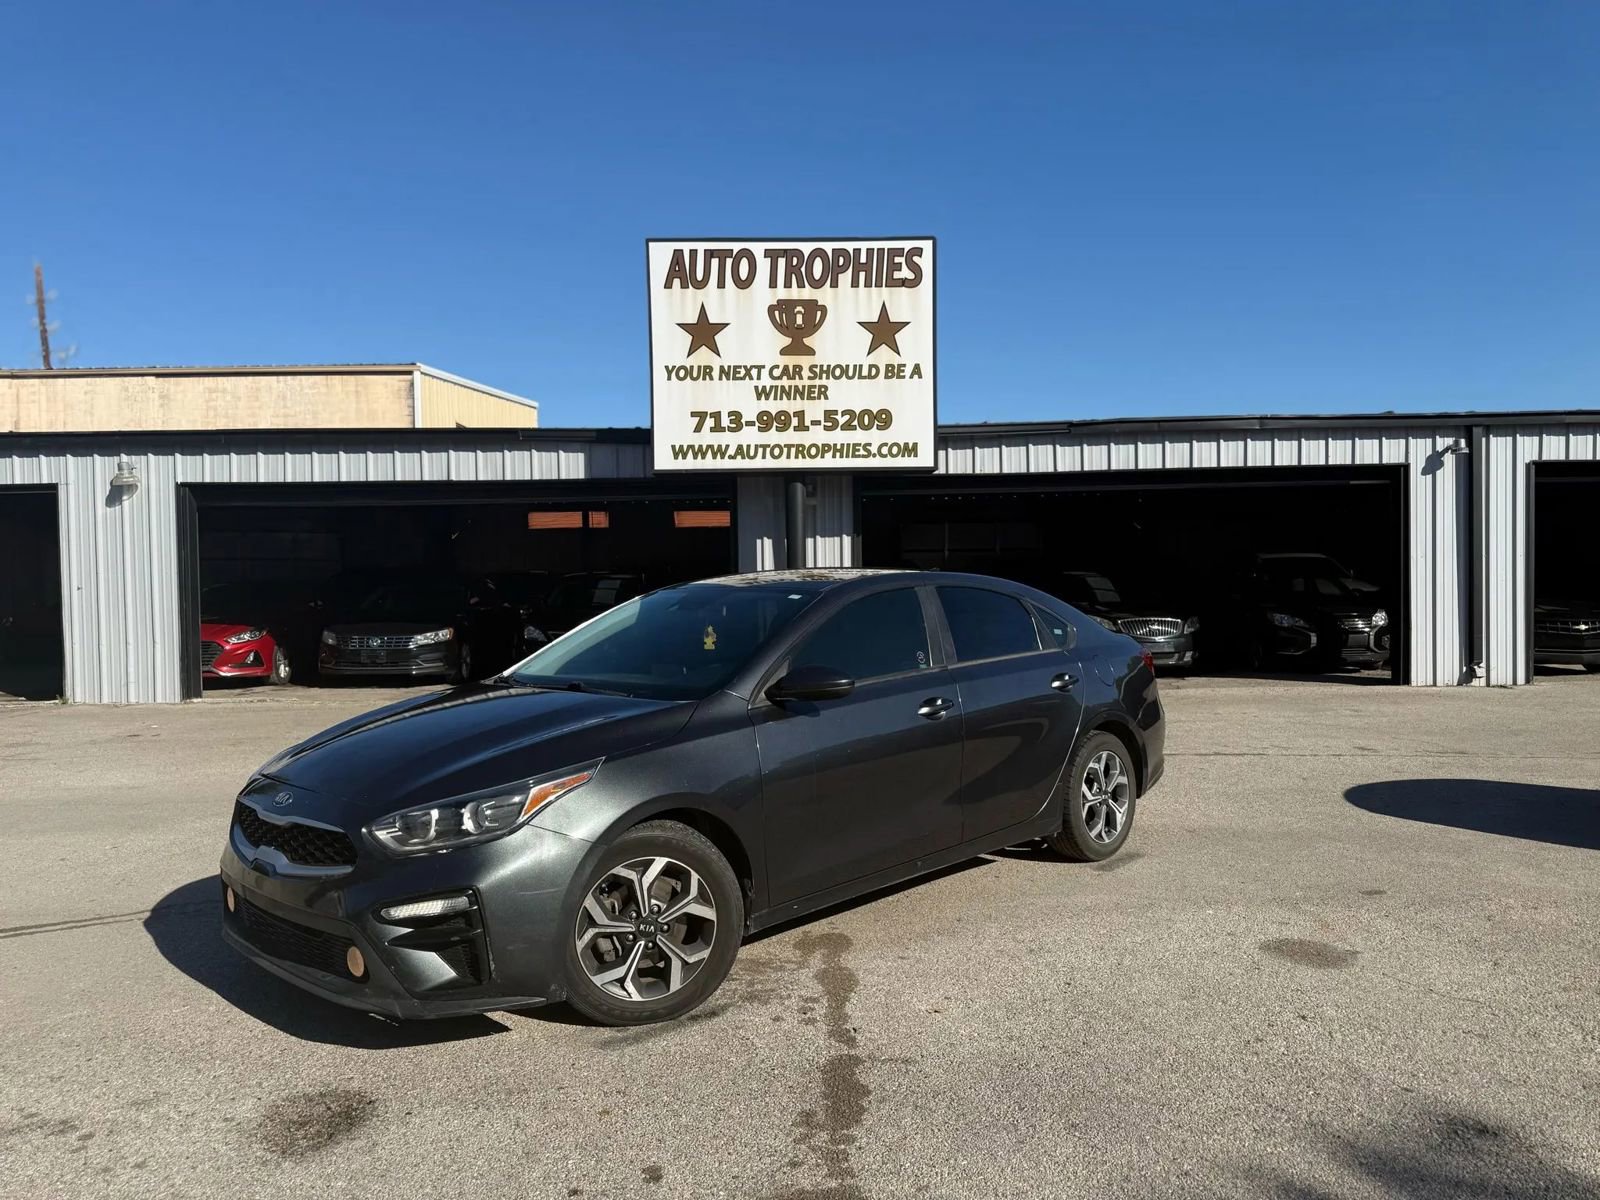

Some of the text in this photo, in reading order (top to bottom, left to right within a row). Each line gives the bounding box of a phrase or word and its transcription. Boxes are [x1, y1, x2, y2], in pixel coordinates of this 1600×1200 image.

[664, 247, 923, 290] AUTO TROPHIES
[665, 363, 923, 381] YOUR NEXT CAR SHOULD BE A
[754, 384, 829, 401] WINNER
[690, 409, 893, 433] 713-991-5209
[671, 442, 918, 460] WWW.AUTOTROPHIES.COM
[639, 924, 655, 932] KIA
